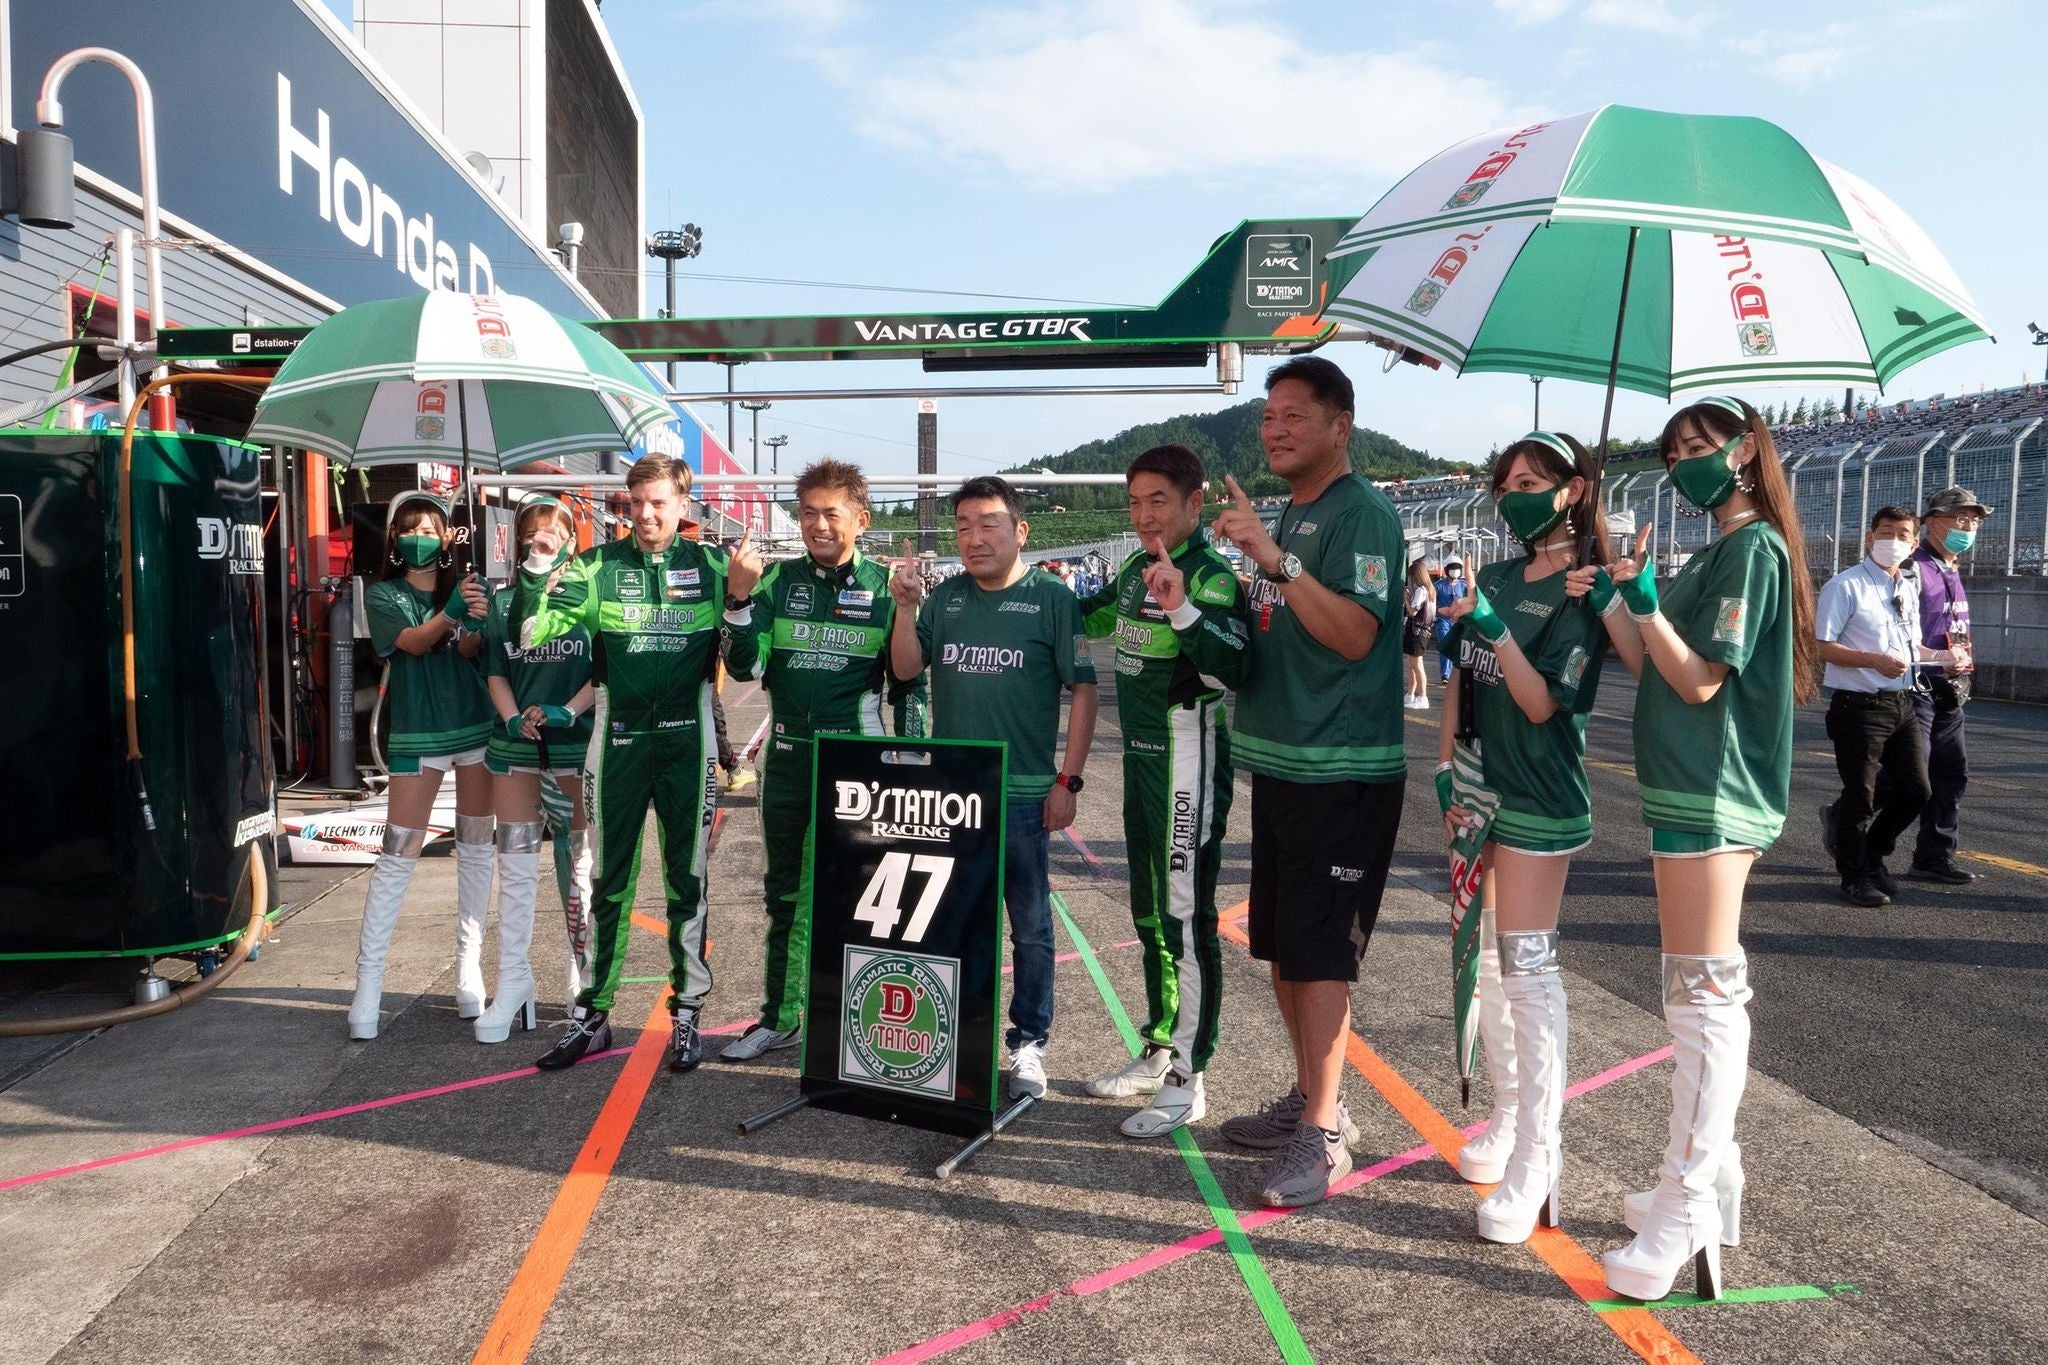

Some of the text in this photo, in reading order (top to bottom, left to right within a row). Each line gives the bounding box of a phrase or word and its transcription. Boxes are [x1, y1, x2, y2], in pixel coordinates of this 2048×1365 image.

[277, 71, 460, 293] Honda
[1259, 257, 1300, 271] AMR
[853, 320, 999, 342] VANTAGE
[622, 605, 696, 624] D'STATION
[791, 622, 867, 646] D'STATION
[941, 642, 1024, 669] D'STATION
[956, 663, 1004, 674] RACING
[834, 780, 983, 830] D'STATION
[323, 825, 368, 837] TECHNO
[871, 821, 951, 842] RACING
[1169, 790, 1191, 873] D'STATION
[1187, 807, 1198, 851] RACING
[853, 851, 956, 943] 47
[850, 962, 949, 1026] DRAMATIC RESORT
[850, 1014, 949, 1079] DRAMATIC RESORT
[865, 1023, 932, 1056] STATION
